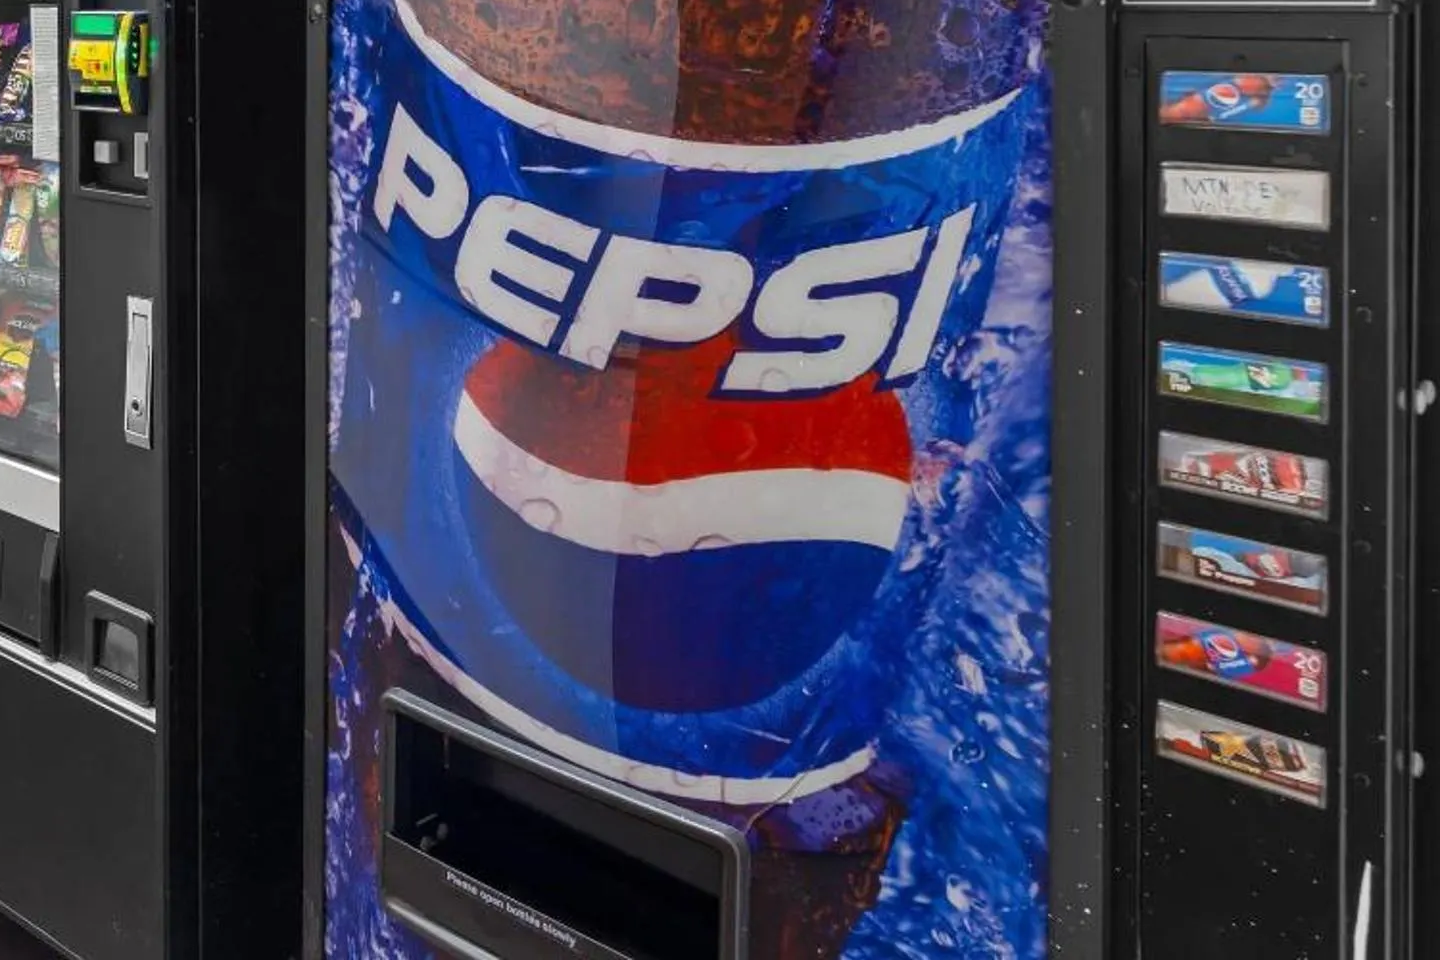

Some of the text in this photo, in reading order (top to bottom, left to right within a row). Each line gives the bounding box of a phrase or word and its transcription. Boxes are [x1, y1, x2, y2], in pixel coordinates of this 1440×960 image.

[1295, 82, 1324, 100] 20
[373, 102, 977, 392] PEPSI
[1293, 651, 1322, 674] 20
[446, 870, 576, 949] Please open bottles slowly
